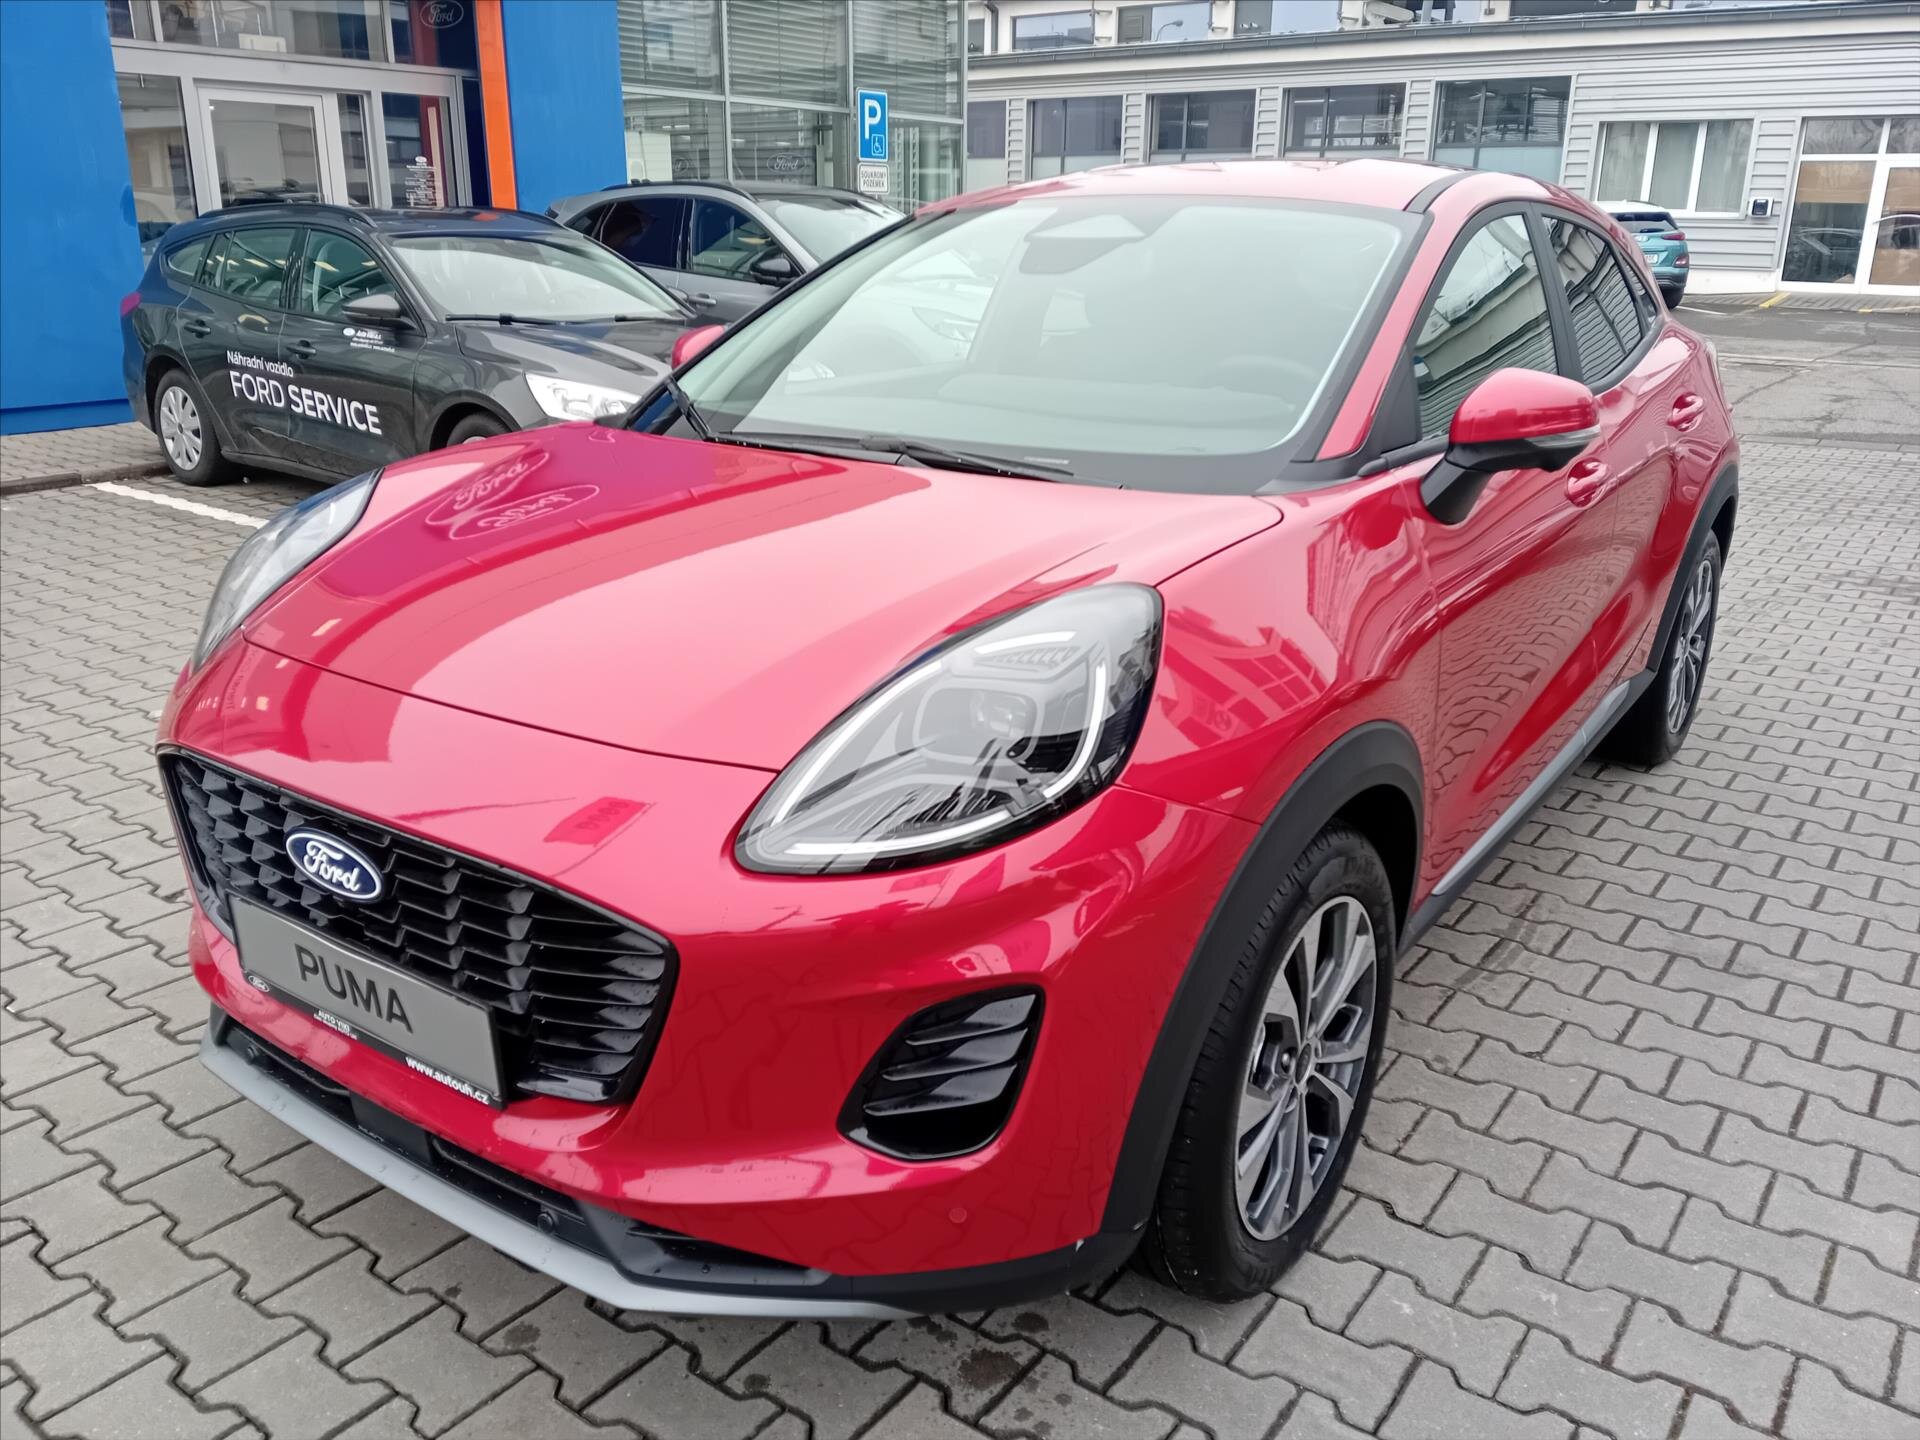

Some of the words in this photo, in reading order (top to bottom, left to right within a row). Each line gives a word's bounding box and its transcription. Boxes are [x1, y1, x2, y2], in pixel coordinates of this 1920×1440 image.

[864, 99, 882, 140] P
[226, 350, 264, 371] Náhradní
[264, 361, 294, 378] vozidlo
[229, 370, 285, 408] FORD
[287, 384, 382, 436] SERVICE
[303, 840, 362, 892] Ford
[294, 943, 414, 1034] PUMA
[405, 1056, 489, 1105] www.autouh.cz
